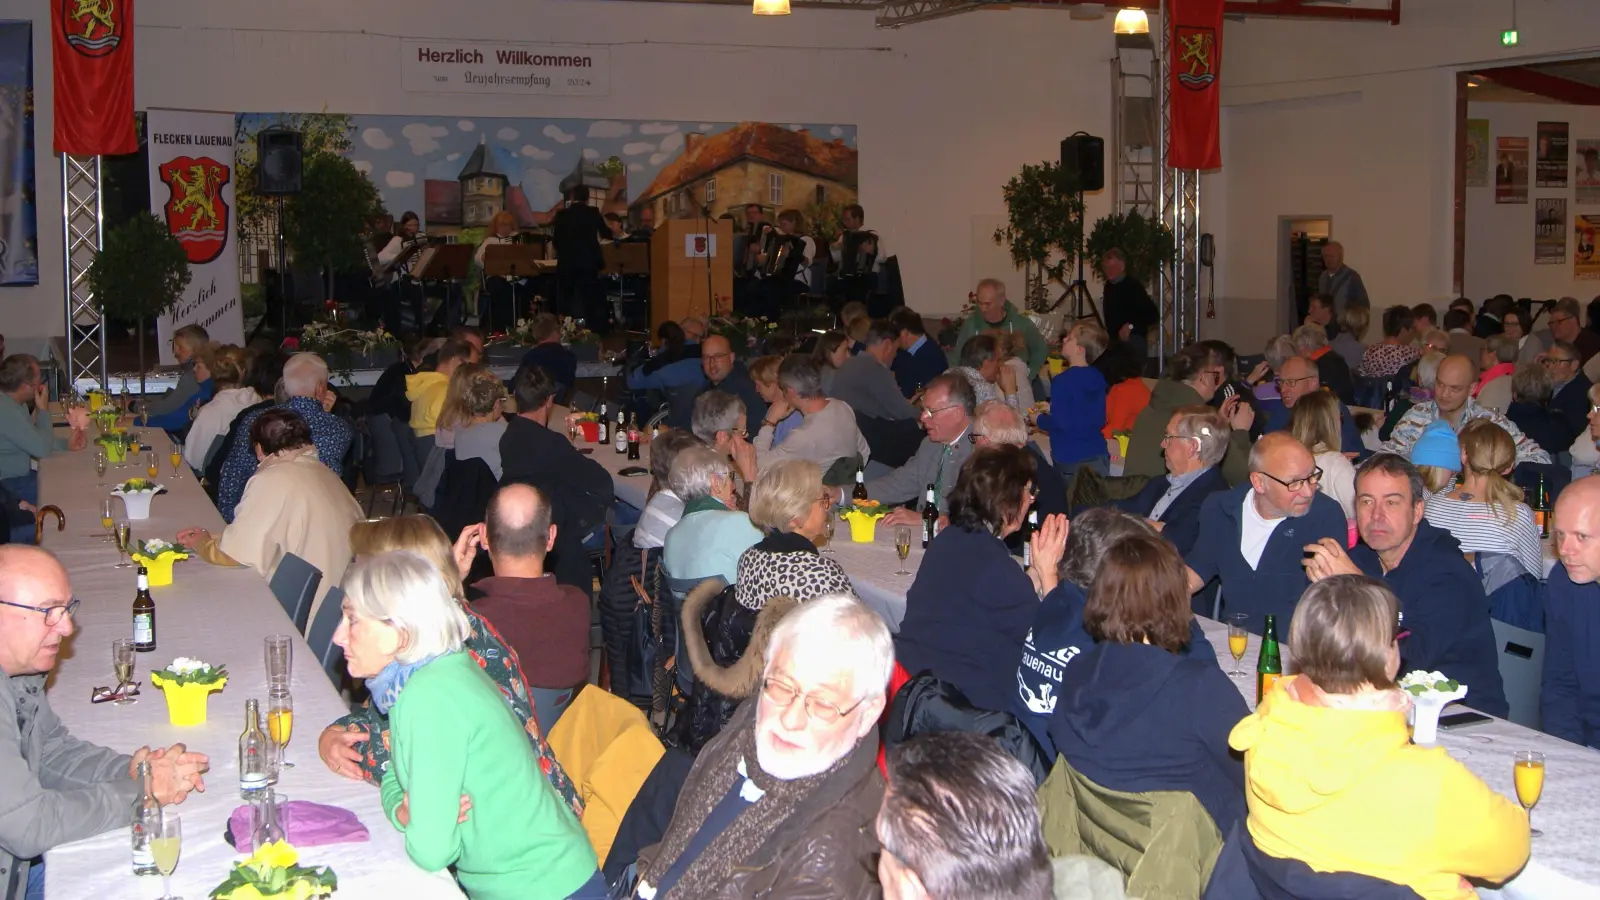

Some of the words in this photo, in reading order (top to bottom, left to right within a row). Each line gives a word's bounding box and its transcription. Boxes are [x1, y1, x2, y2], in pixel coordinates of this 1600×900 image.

[418, 48, 483, 64] Herzlich
[496, 50, 592, 68] Willkommen
[153, 133, 192, 145] FLECKEN
[194, 135, 232, 147] LAUENAU
[172, 277, 216, 325] Herzlich
[1021, 649, 1063, 683] auenau
